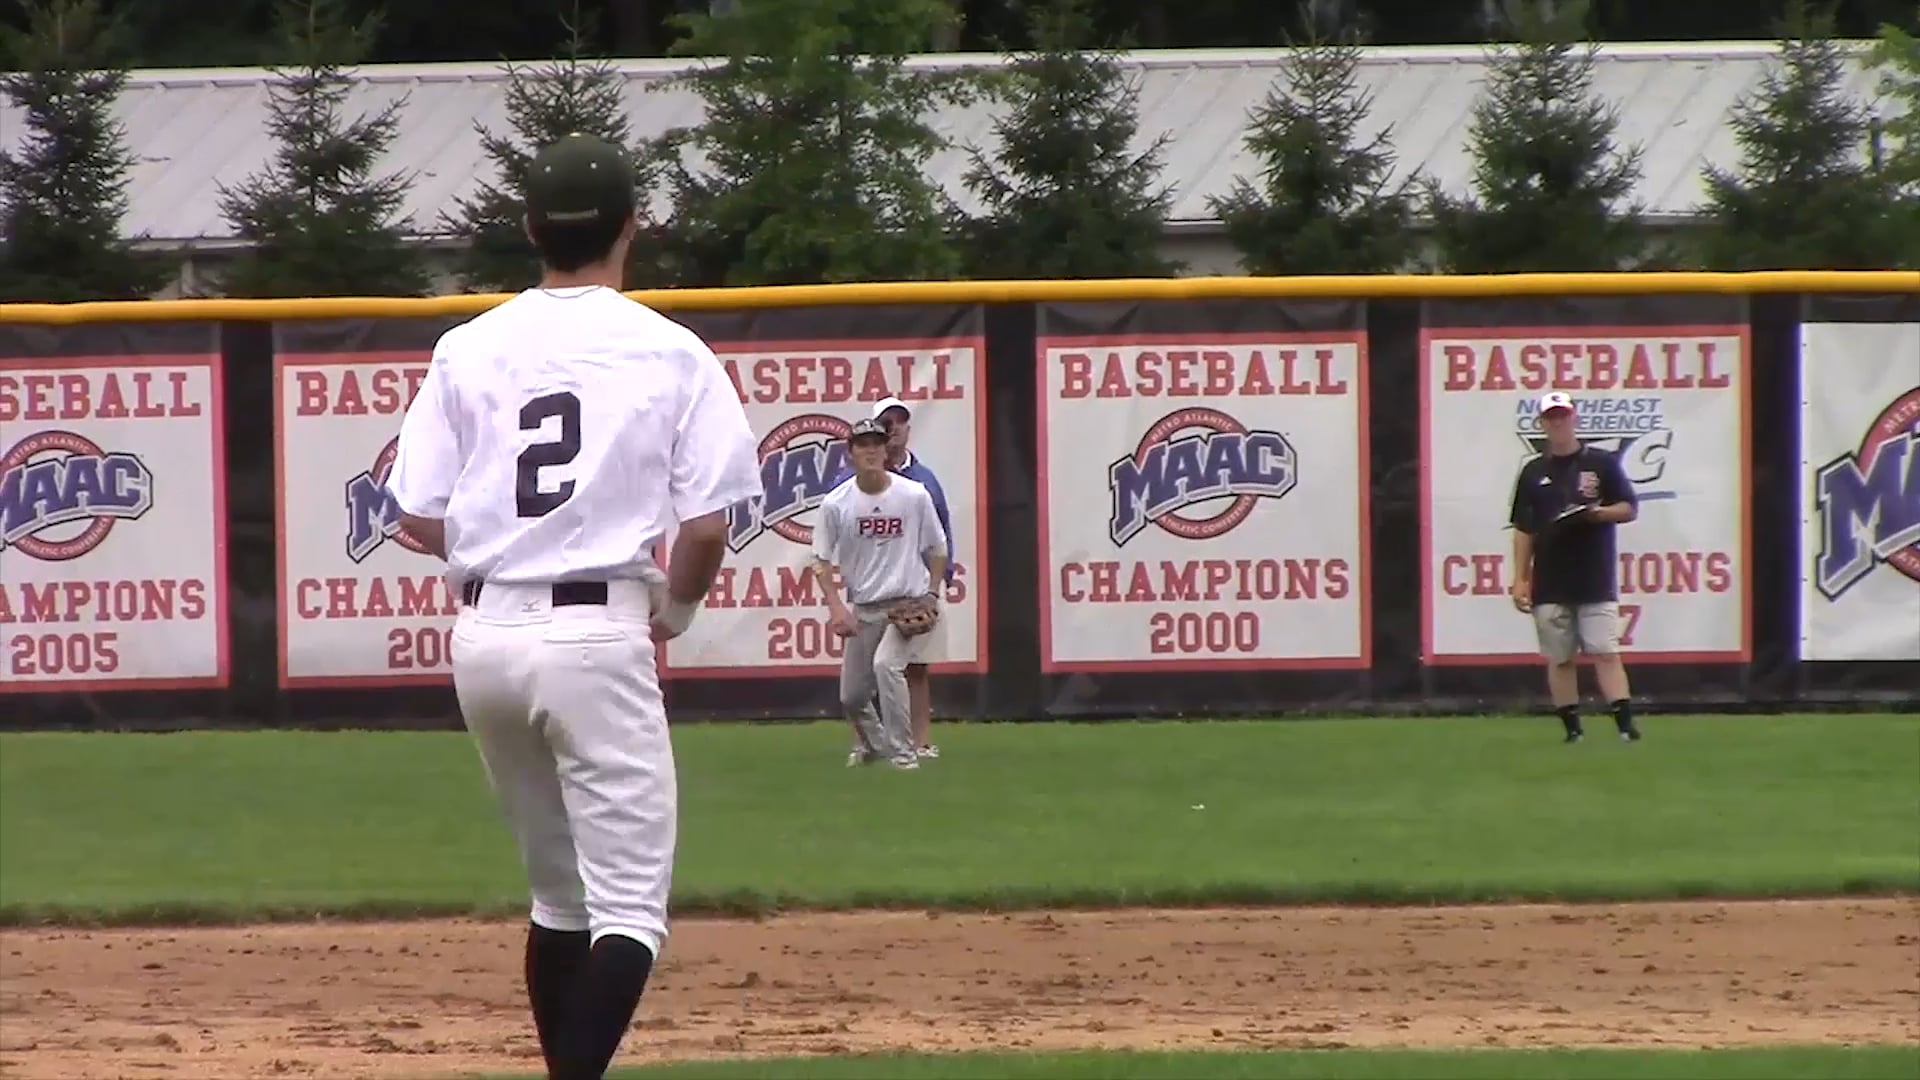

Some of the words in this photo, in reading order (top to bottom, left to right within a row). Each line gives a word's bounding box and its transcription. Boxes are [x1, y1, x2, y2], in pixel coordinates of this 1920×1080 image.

[1060, 351, 1348, 398] BASEBALL
[1443, 343, 1729, 391] BASEBALL
[1517, 398, 1662, 415] NTHEAST
[1517, 415, 1663, 431] COERENCE
[515, 391, 582, 518] 2
[1110, 432, 1296, 547] MAAC
[858, 517, 904, 538] PBR
[1061, 558, 1349, 602] CHAMPIONS
[11, 633, 118, 675] 2005
[1150, 612, 1260, 654] 2000
